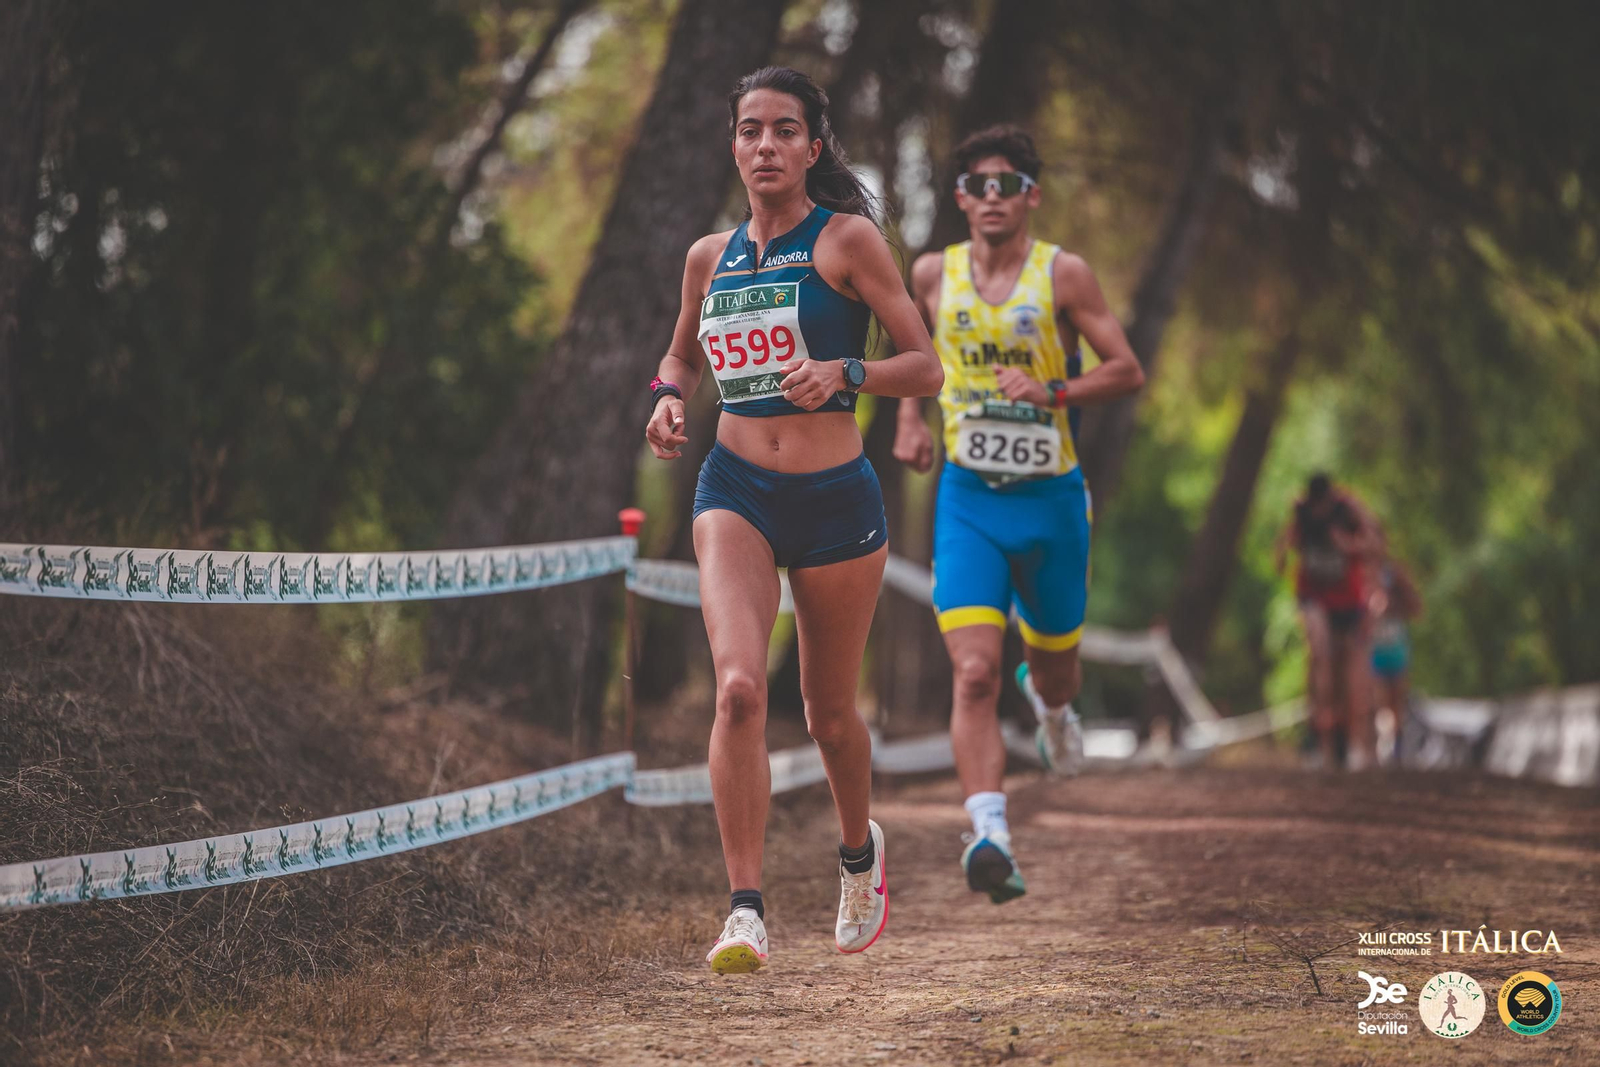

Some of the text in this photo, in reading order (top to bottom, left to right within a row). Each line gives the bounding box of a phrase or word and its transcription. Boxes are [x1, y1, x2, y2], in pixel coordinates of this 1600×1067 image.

[764, 251, 808, 267] ANDORRA
[718, 290, 767, 309] ITÁLICA
[707, 325, 796, 372] 5599
[968, 431, 1051, 467] 8265
